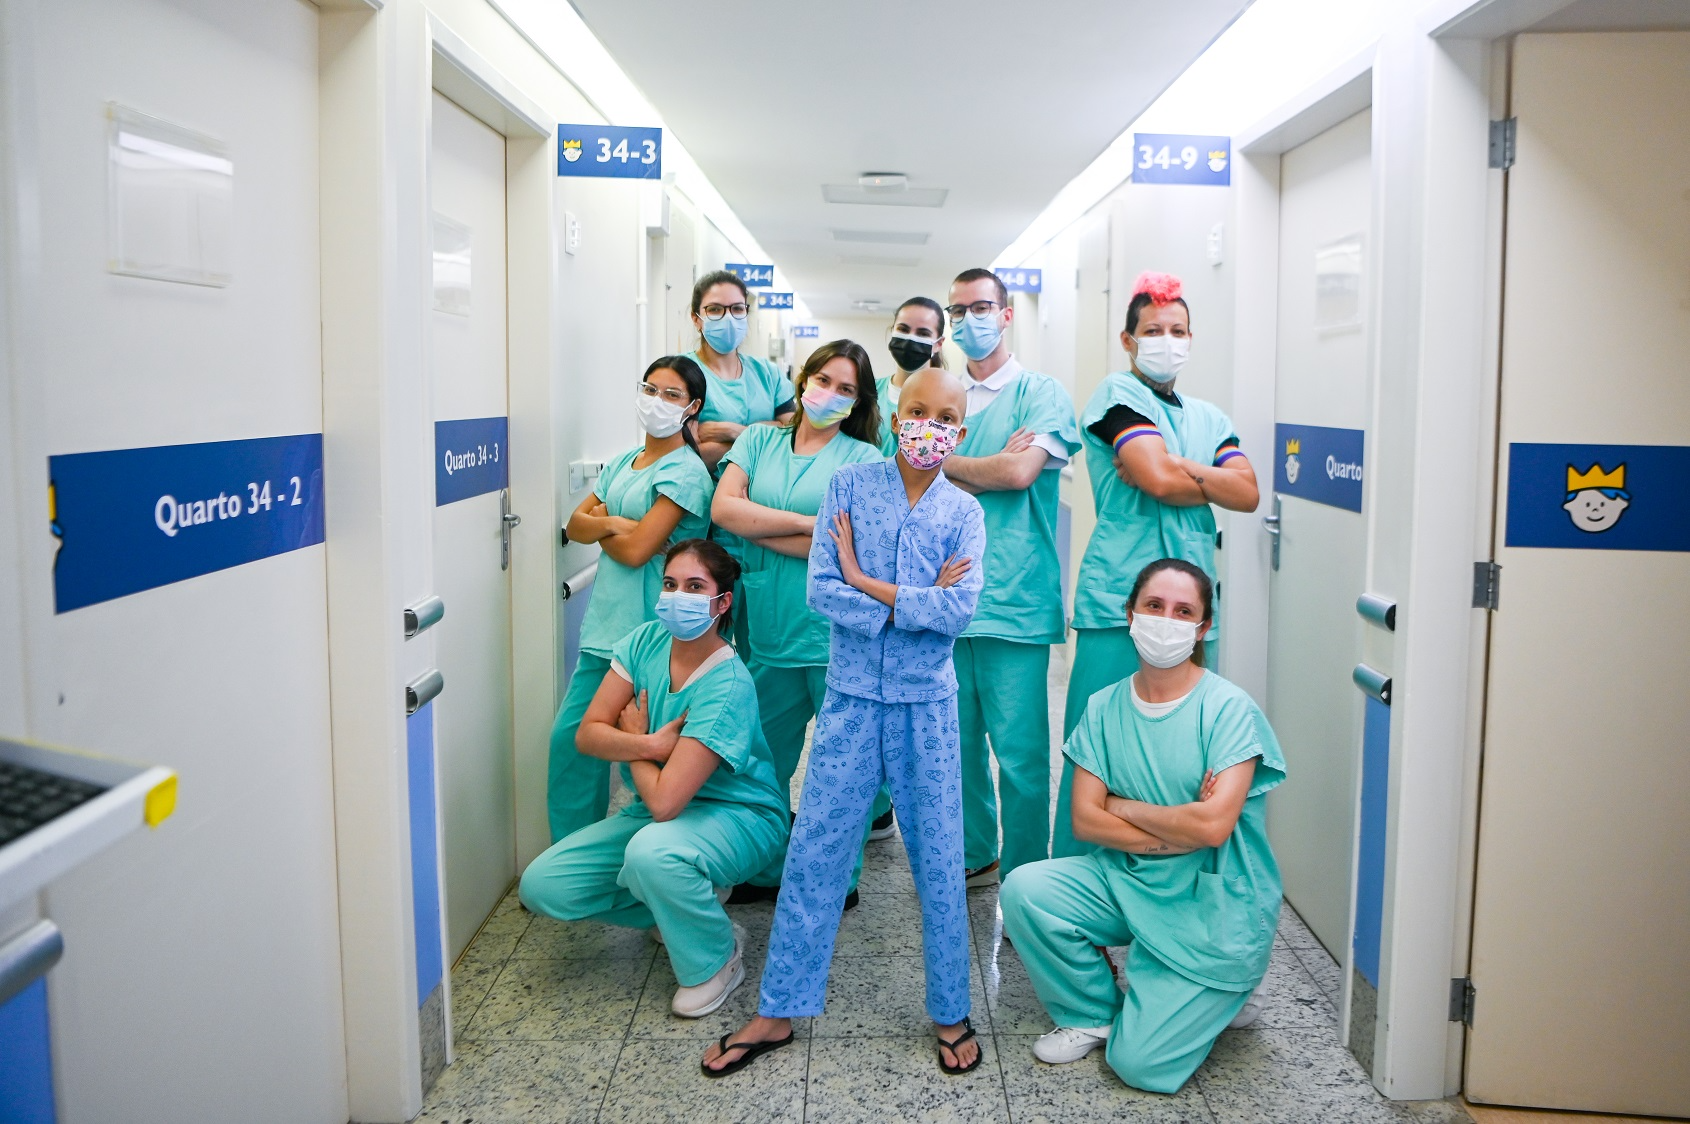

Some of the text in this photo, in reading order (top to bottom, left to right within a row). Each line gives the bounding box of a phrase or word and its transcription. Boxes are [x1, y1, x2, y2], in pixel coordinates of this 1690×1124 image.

[596, 137, 656, 164] 34-3
[1137, 145, 1198, 170] 34-9
[743, 268, 772, 282] 34-4
[770, 295, 793, 306] 34-5
[444, 449, 476, 475] Quarto
[1325, 454, 1362, 481] Quarto
[154, 491, 242, 537] Quarto
[290, 476, 303, 507] 2
